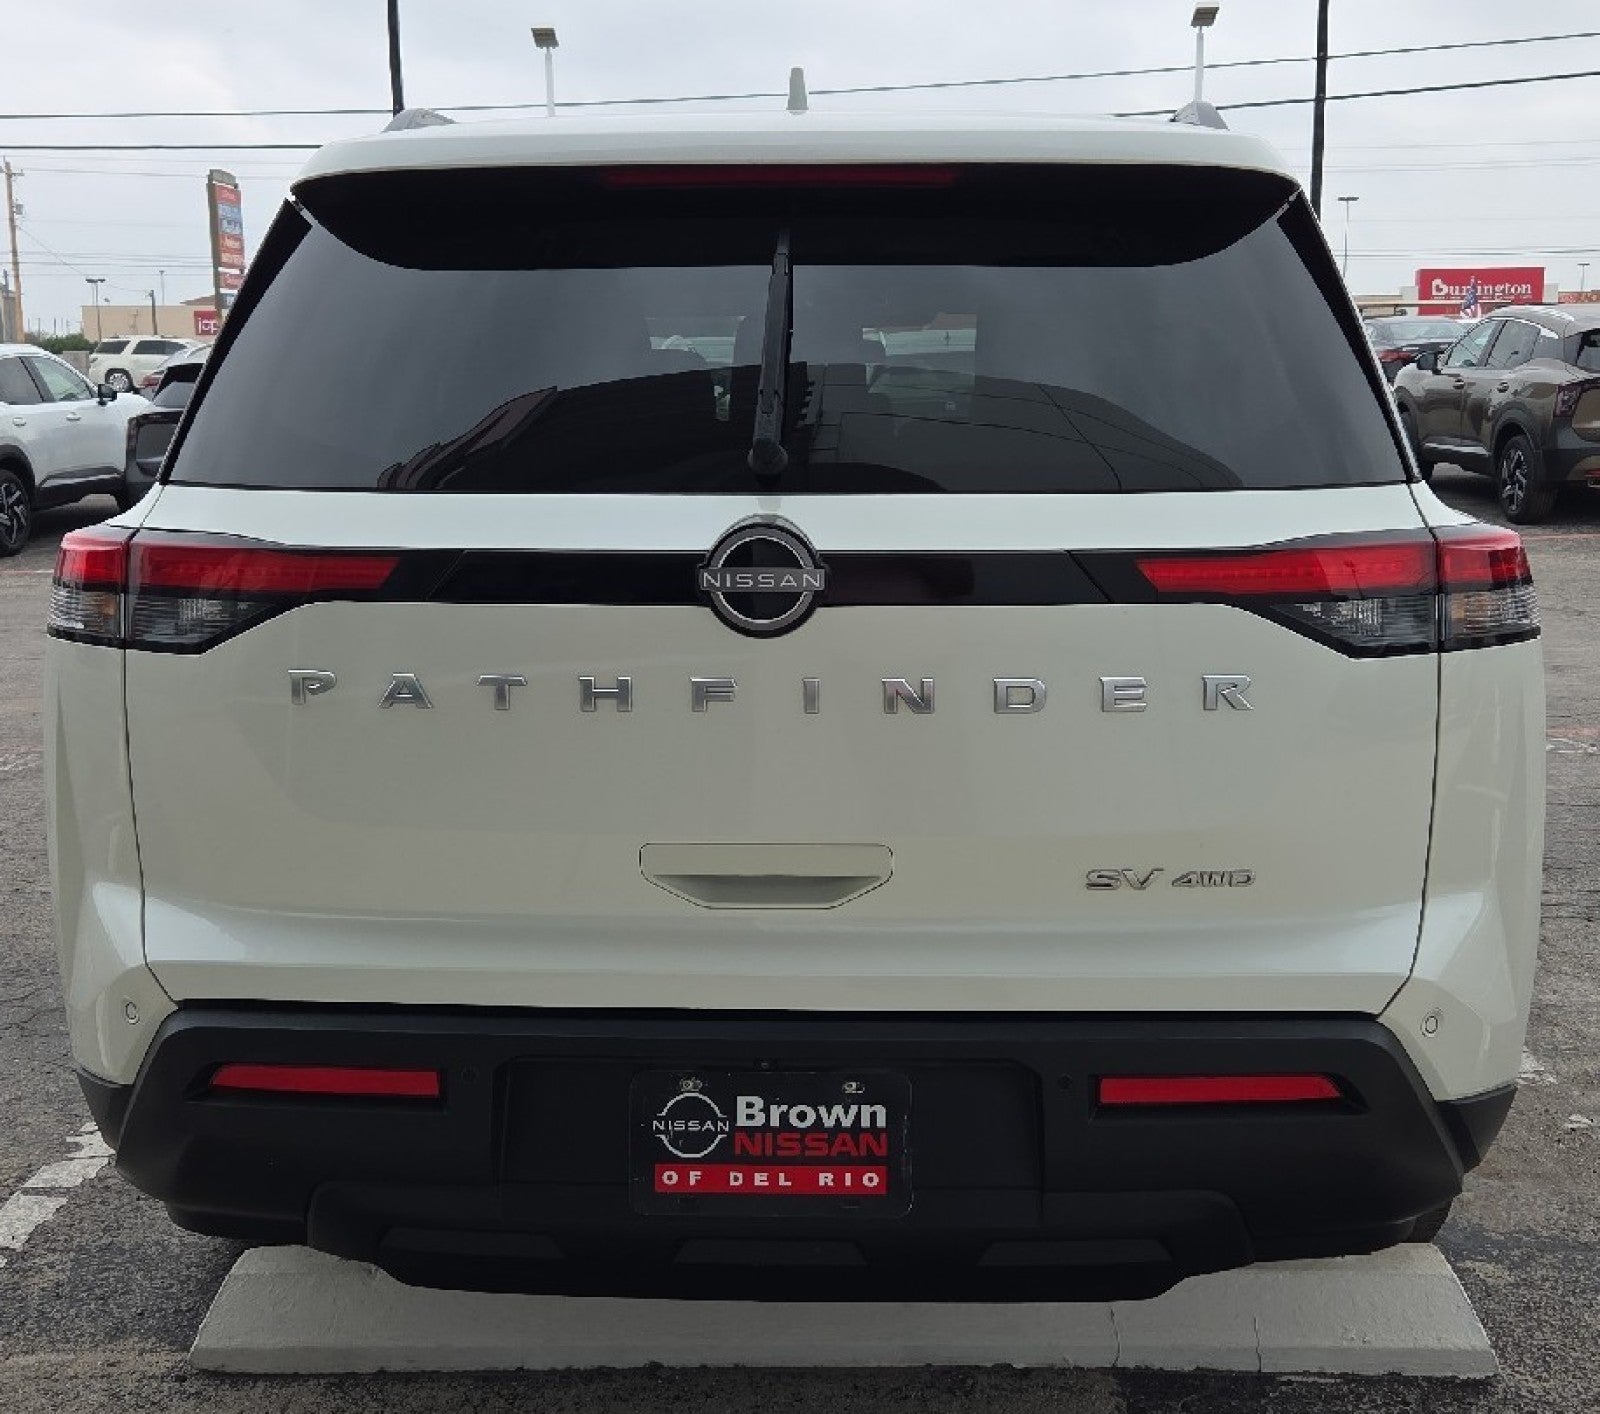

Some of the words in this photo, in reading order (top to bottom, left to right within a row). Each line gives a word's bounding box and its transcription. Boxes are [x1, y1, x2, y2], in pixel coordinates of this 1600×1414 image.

[1431, 278, 1533, 300] Burington
[702, 571, 821, 589] NISSAN
[287, 668, 1255, 715] PATHFINDER
[1085, 868, 1165, 891] SV
[1171, 868, 1257, 888] 4WD
[735, 1095, 887, 1129] Brown
[652, 1119, 730, 1132] NISSAN
[734, 1132, 888, 1157] NISSAN
[661, 1171, 703, 1186] OF
[729, 1171, 793, 1187] DEL
[818, 1172, 880, 1187] RIO
